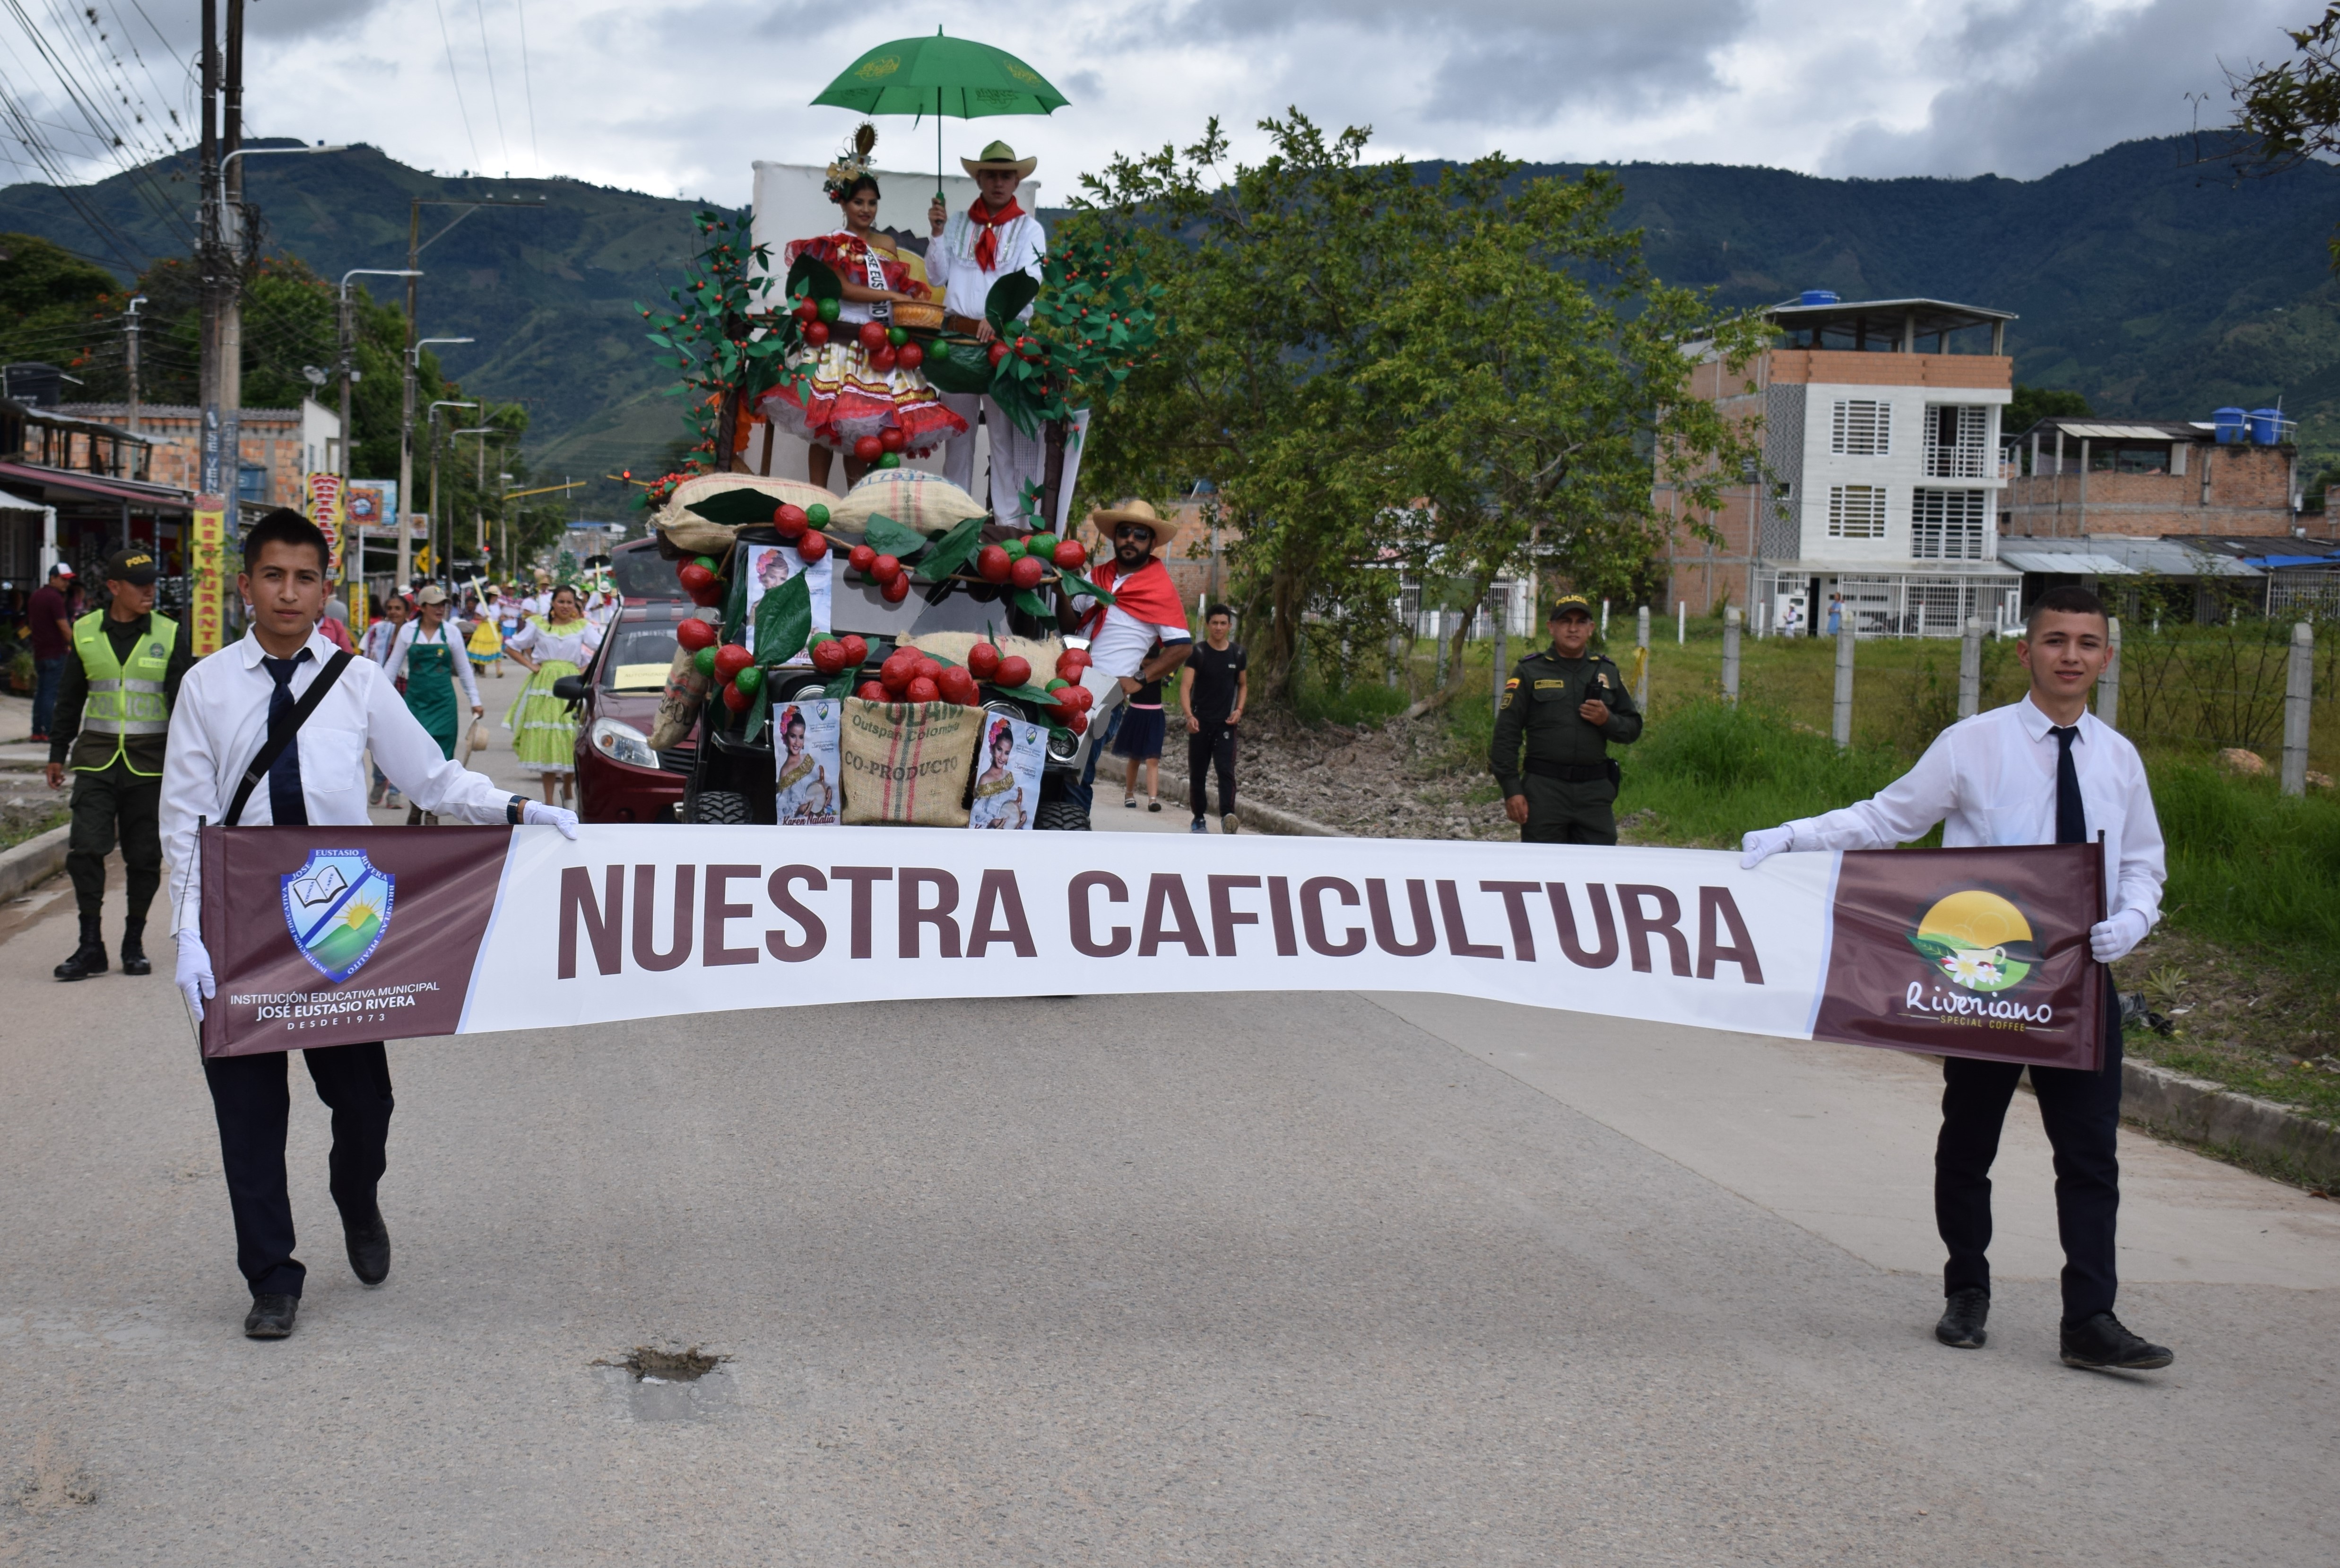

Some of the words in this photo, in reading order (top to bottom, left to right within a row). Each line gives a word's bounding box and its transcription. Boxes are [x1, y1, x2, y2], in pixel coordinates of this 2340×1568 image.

[198, 517, 217, 653] RESTAURANTE
[1555, 594, 1588, 606] POLICIA
[845, 750, 958, 780] CO-PRODUCTO
[782, 815, 806, 825] Karen
[806, 813, 835, 825] Natalia
[361, 855, 388, 881] RIVERA
[282, 887, 294, 934] EDUCATIVA
[379, 884, 395, 934] BRUSELAS
[558, 864, 1038, 979] NUESTRA
[1068, 870, 1764, 985] CAFICULTURA
[347, 939, 380, 974] PITALITO
[230, 991, 307, 1005] INSTITUCIÓN
[311, 989, 376, 1003] EDUCATIVA
[378, 981, 440, 996] MUNICIPAL
[1906, 981, 2052, 1023] Riveriano
[256, 1003, 291, 1022] JOSÉ
[295, 1001, 363, 1017] EUSTASIO
[365, 995, 416, 1010] RIVERA
[287, 1018, 338, 1030] DESDE
[346, 1013, 385, 1024] 1973
[1940, 1015, 1982, 1028] SPECIAL
[1989, 1021, 2026, 1032] COFFEE
